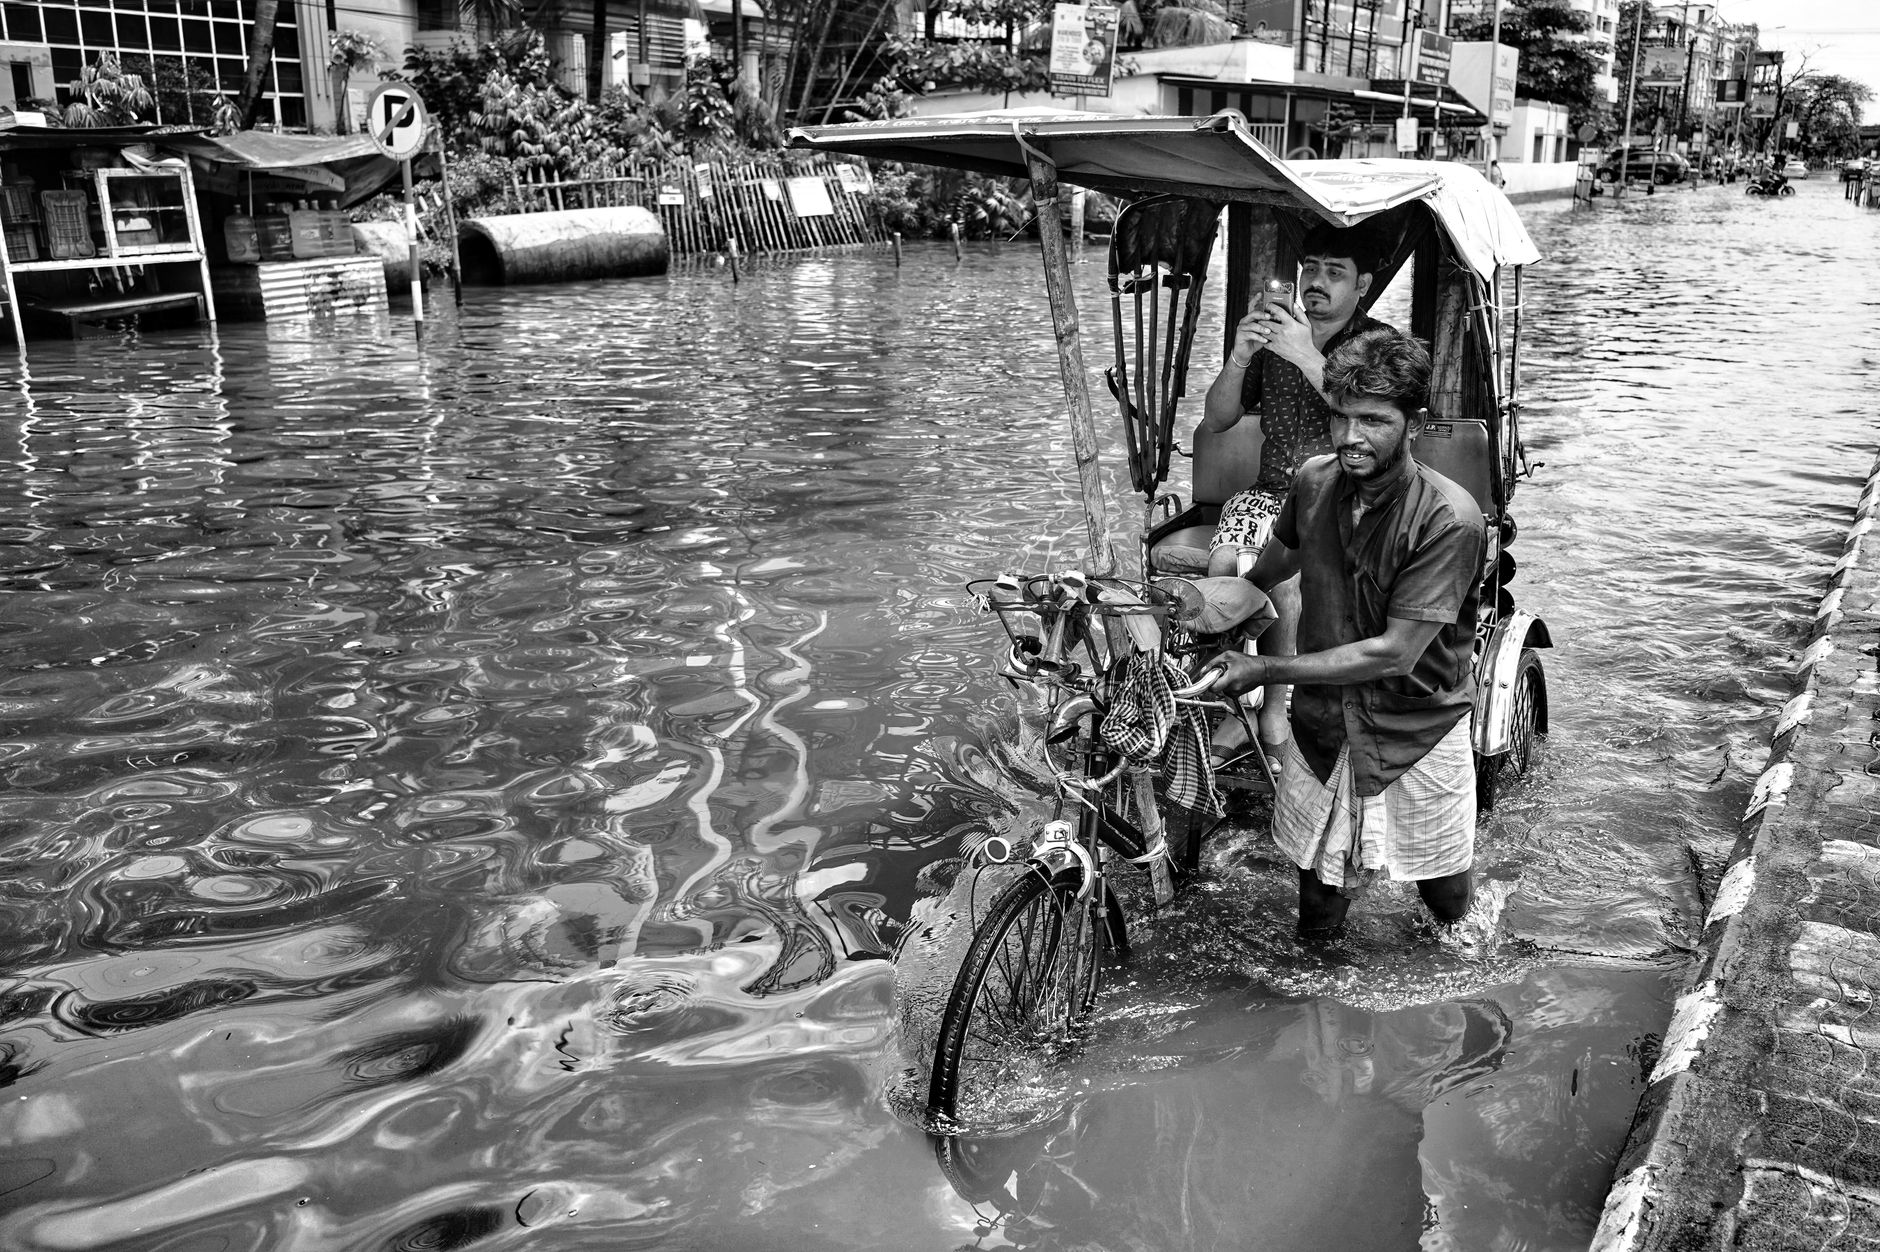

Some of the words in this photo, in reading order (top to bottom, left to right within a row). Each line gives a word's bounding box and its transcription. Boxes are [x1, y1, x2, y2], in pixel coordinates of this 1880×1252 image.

[1055, 73, 1076, 82] TRAIN
[1077, 75, 1087, 83] TO
[1087, 76, 1105, 84] FLEX
[384, 94, 415, 147] P
